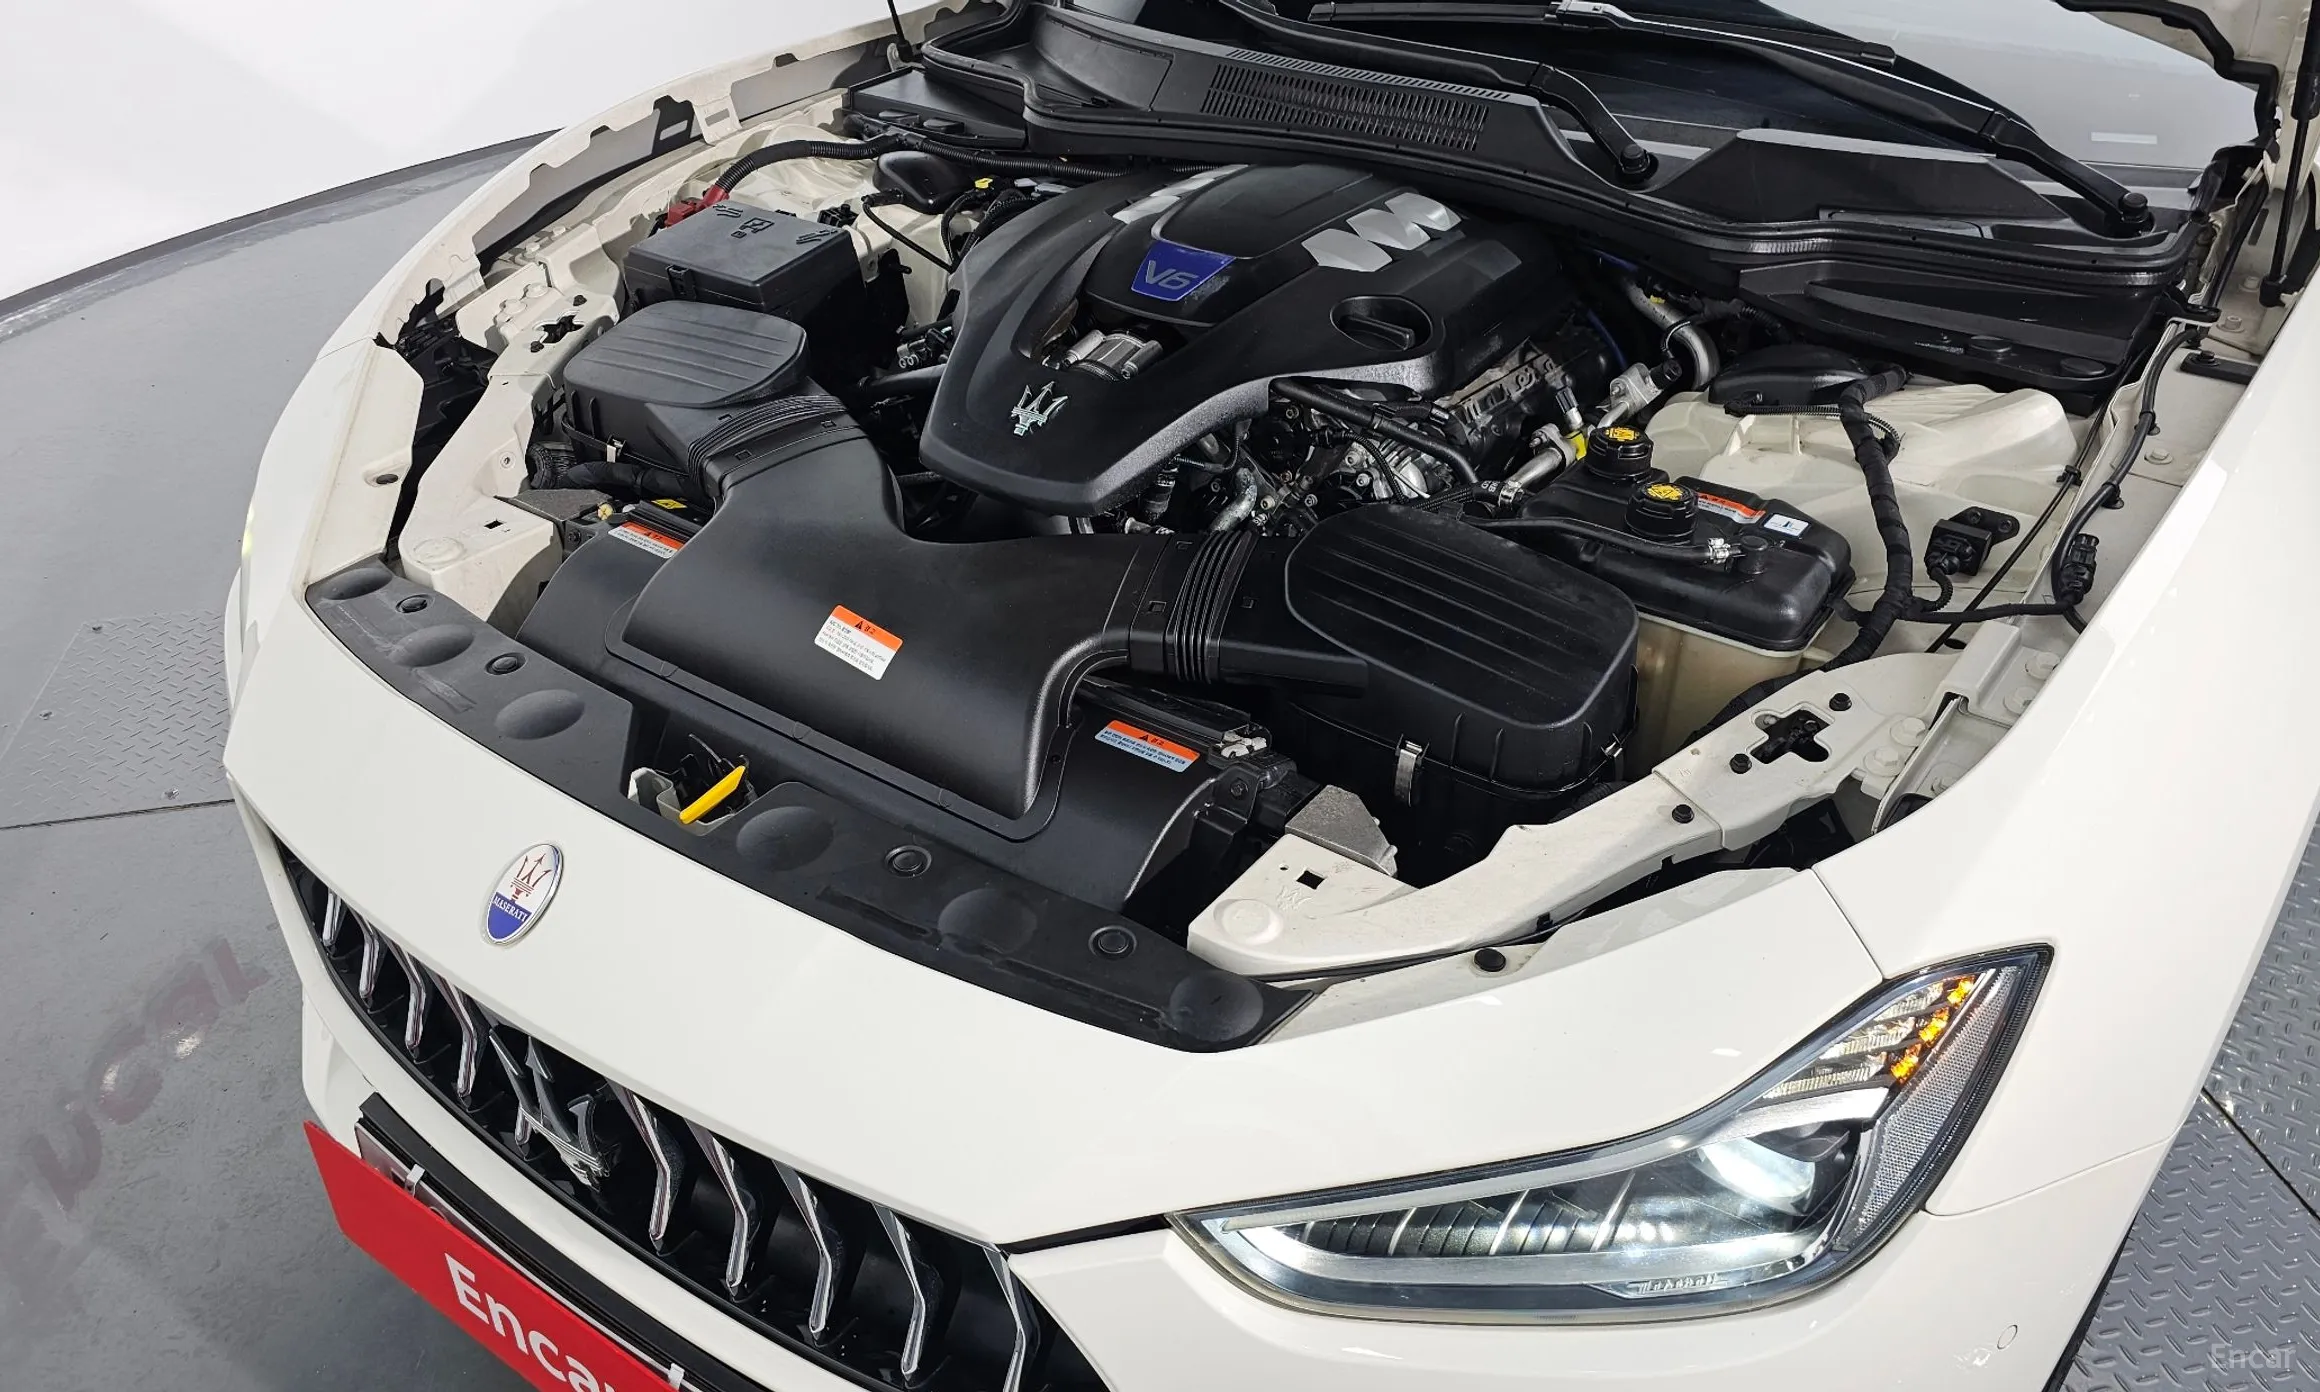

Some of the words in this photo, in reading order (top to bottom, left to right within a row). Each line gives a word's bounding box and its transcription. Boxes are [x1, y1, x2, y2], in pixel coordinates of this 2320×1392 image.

[1145, 260, 1199, 290] V6
[492, 895, 529, 922] MASERATI
[444, 1252, 616, 1392] Enca
